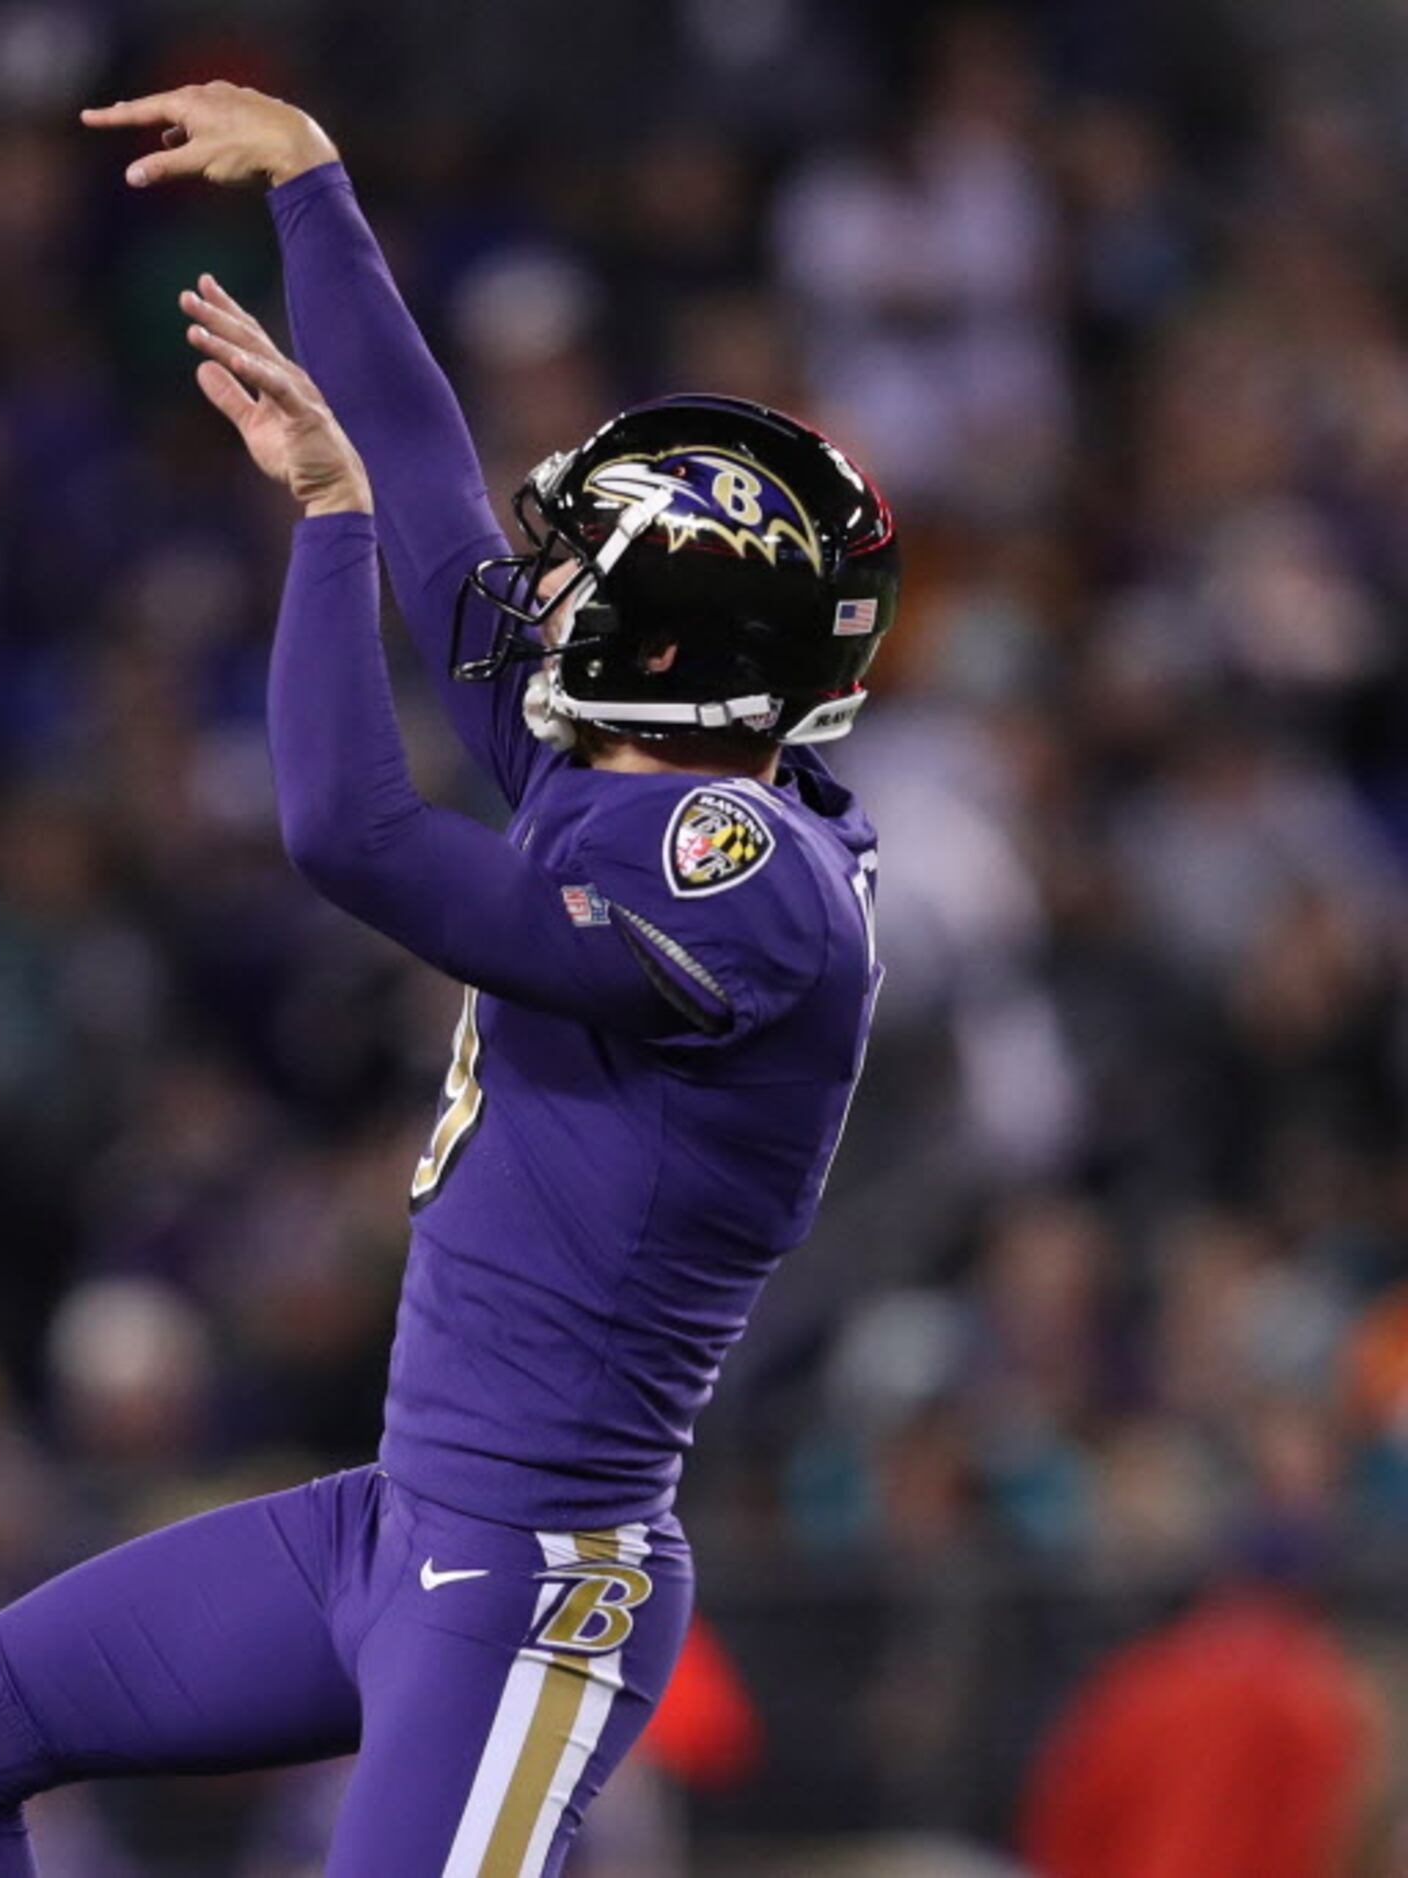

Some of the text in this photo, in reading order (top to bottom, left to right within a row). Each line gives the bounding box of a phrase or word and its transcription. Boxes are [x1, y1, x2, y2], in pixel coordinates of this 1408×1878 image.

[692, 457, 762, 525] B
[698, 796, 763, 845] RAVENS
[532, 1564, 652, 1652] B
